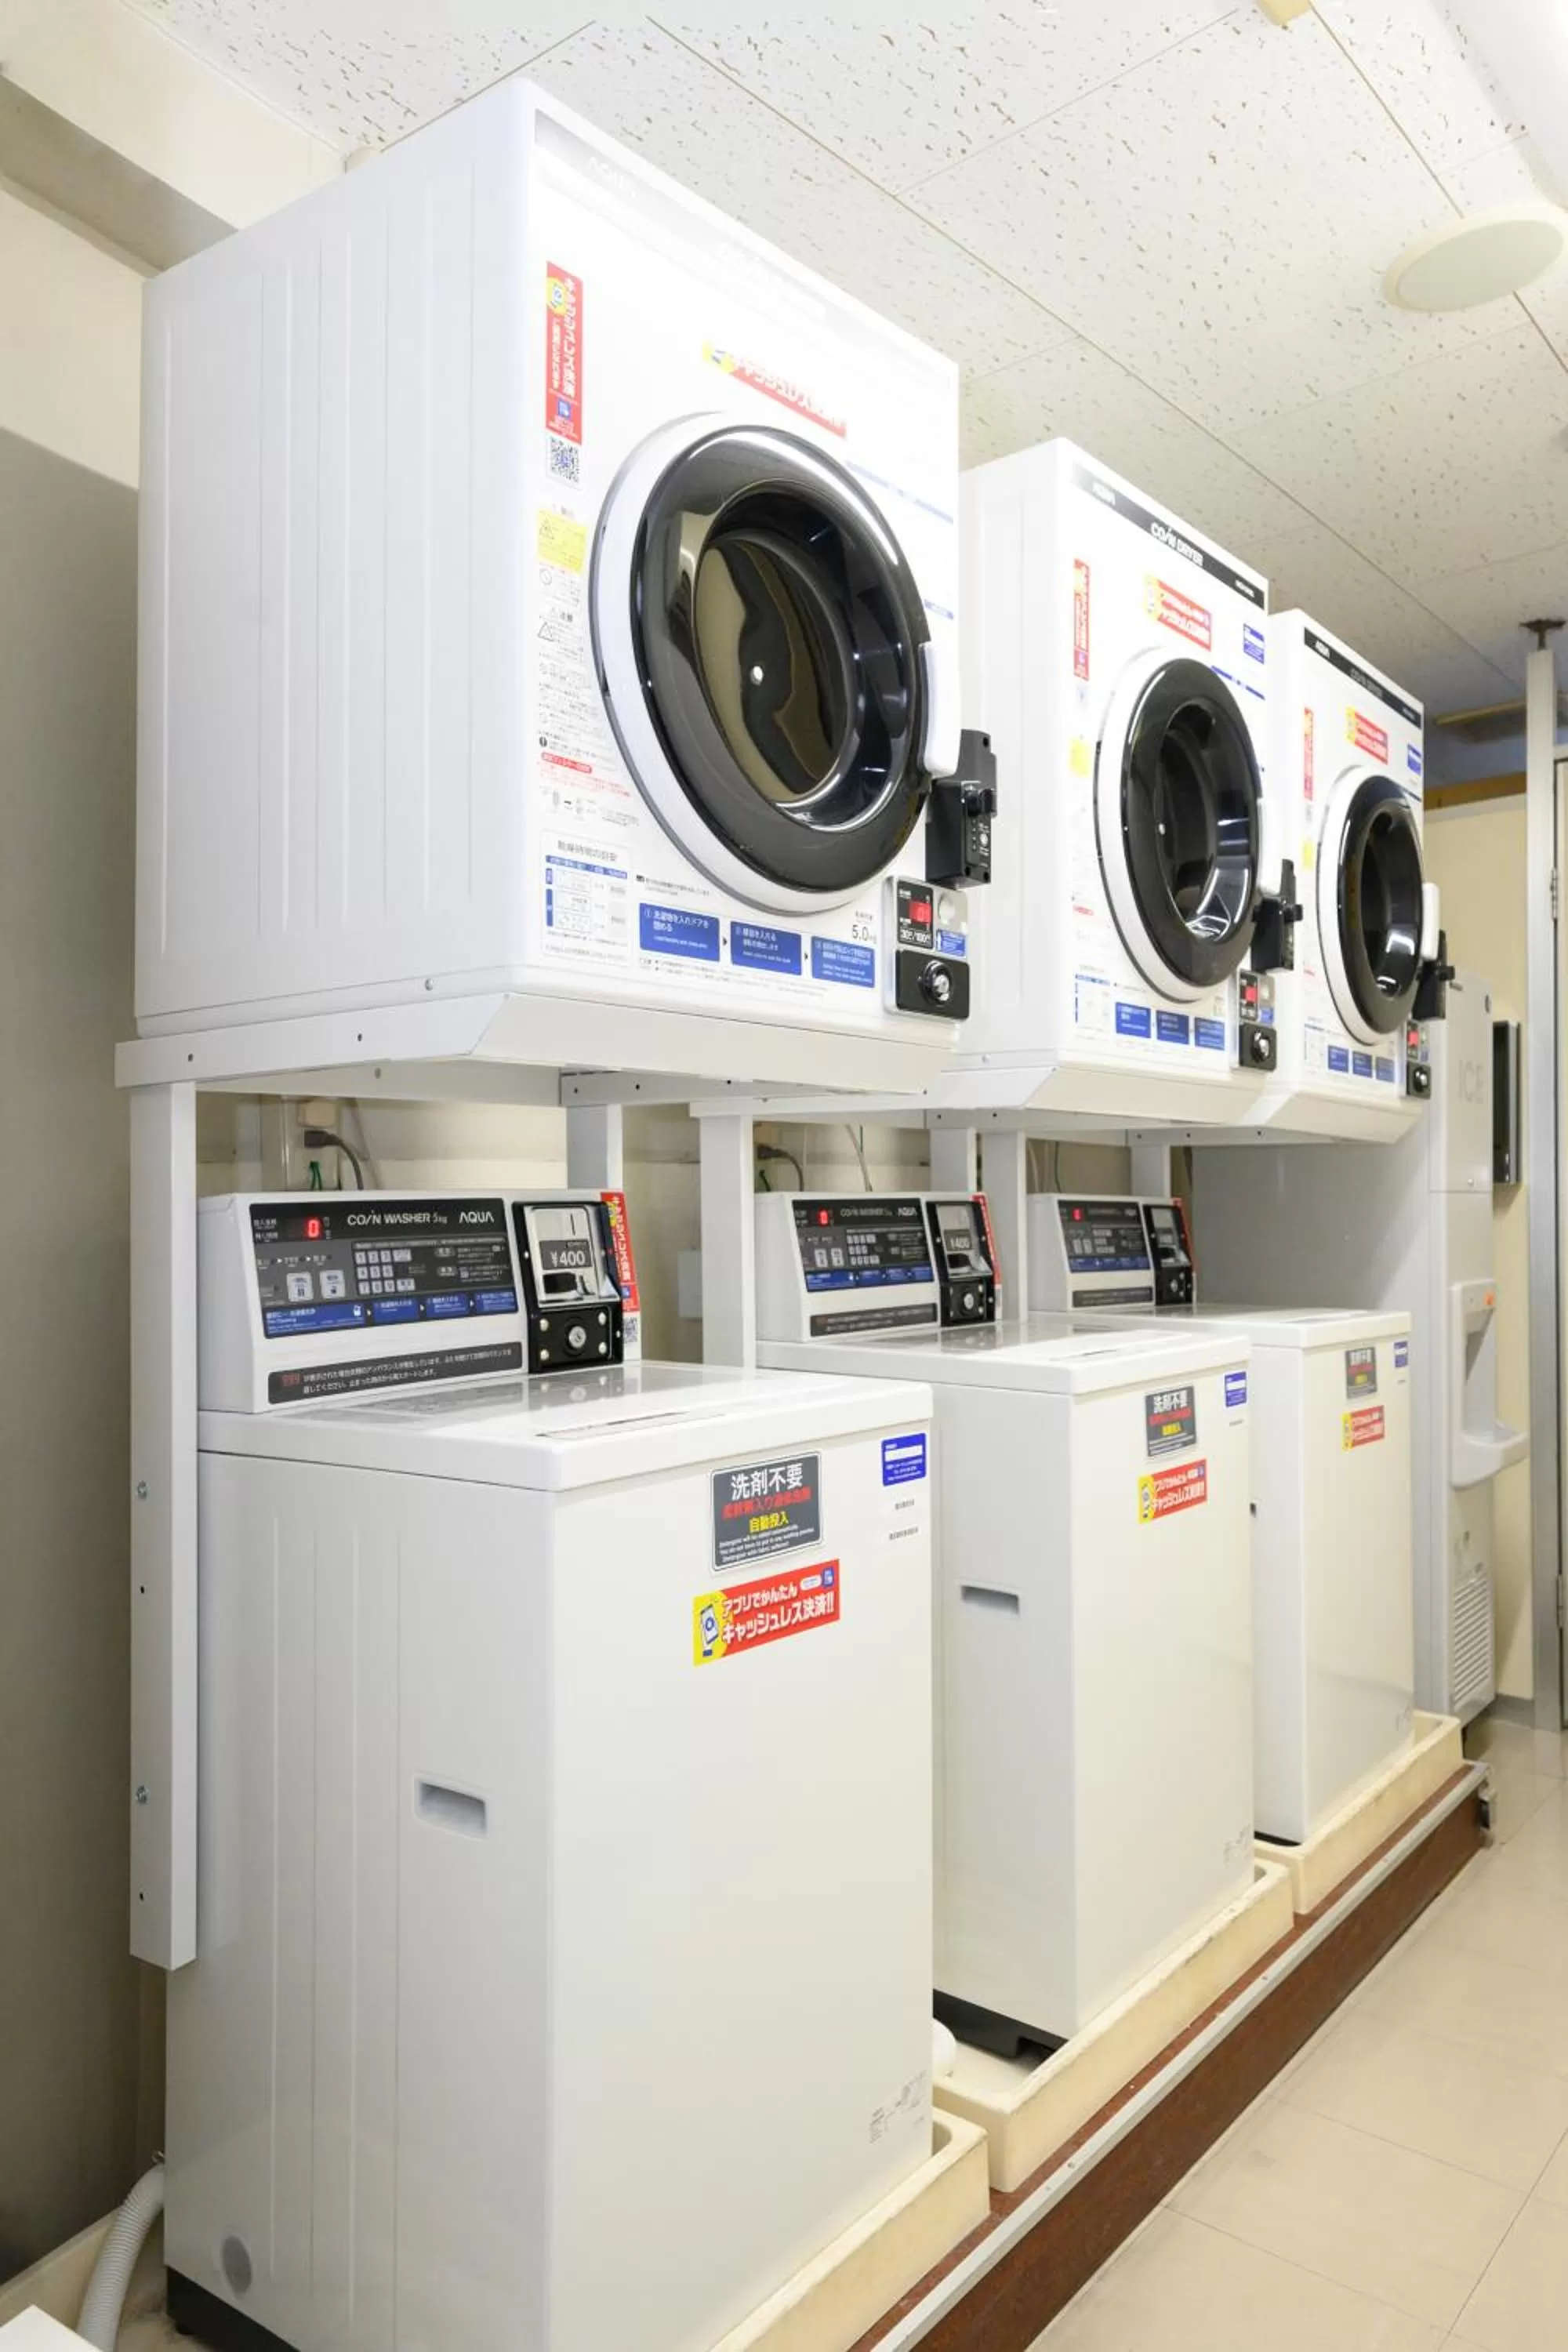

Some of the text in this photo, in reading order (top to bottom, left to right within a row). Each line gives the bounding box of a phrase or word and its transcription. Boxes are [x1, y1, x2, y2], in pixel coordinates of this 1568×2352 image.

[383, 1210, 430, 1224] WASHER
[459, 1211, 494, 1223] AQUA
[550, 1250, 586, 1266] ¥400
[731, 1463, 803, 1501] 洗剤不要
[723, 1582, 797, 1617] アプリでかんたん
